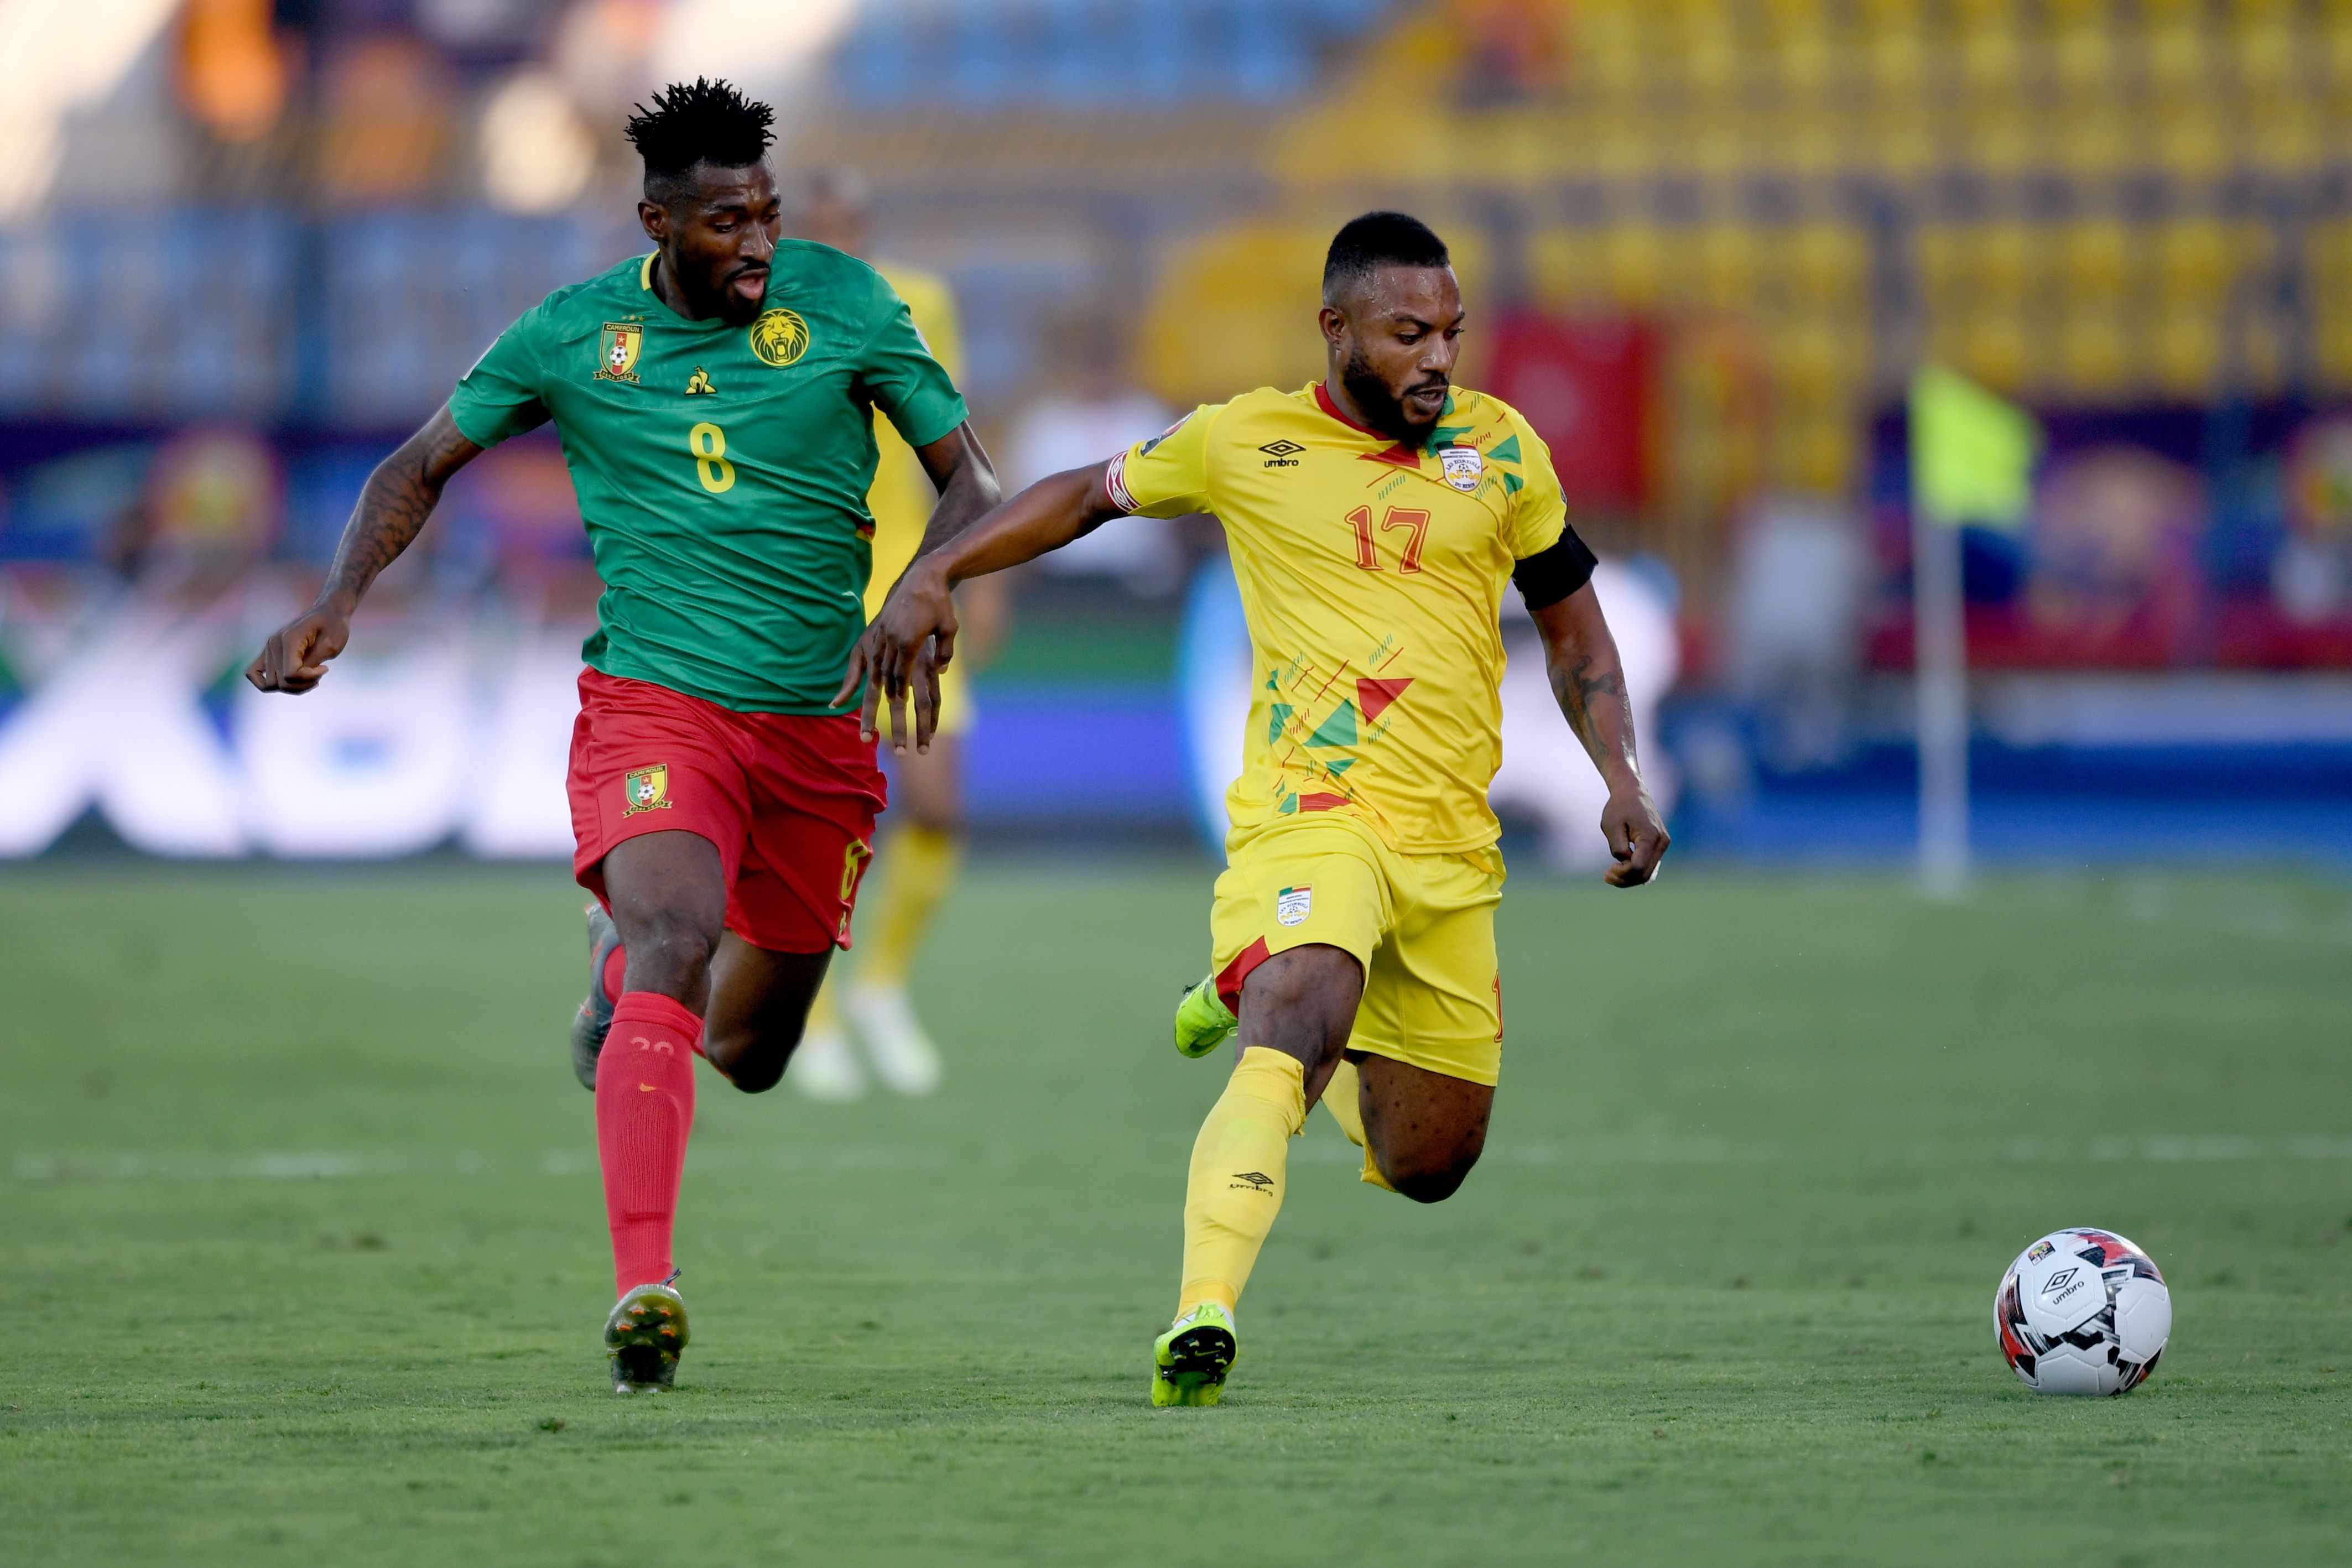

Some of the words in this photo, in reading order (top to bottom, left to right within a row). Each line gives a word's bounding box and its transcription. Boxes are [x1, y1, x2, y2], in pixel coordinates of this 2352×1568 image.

[606, 324, 640, 332] CAMEROUN
[690, 422, 736, 494] 8
[1264, 458, 1299, 468] umbro
[1344, 504, 1431, 574] 17
[629, 767, 663, 778] CAMEROUN
[2053, 1280, 2084, 1305] umbro
